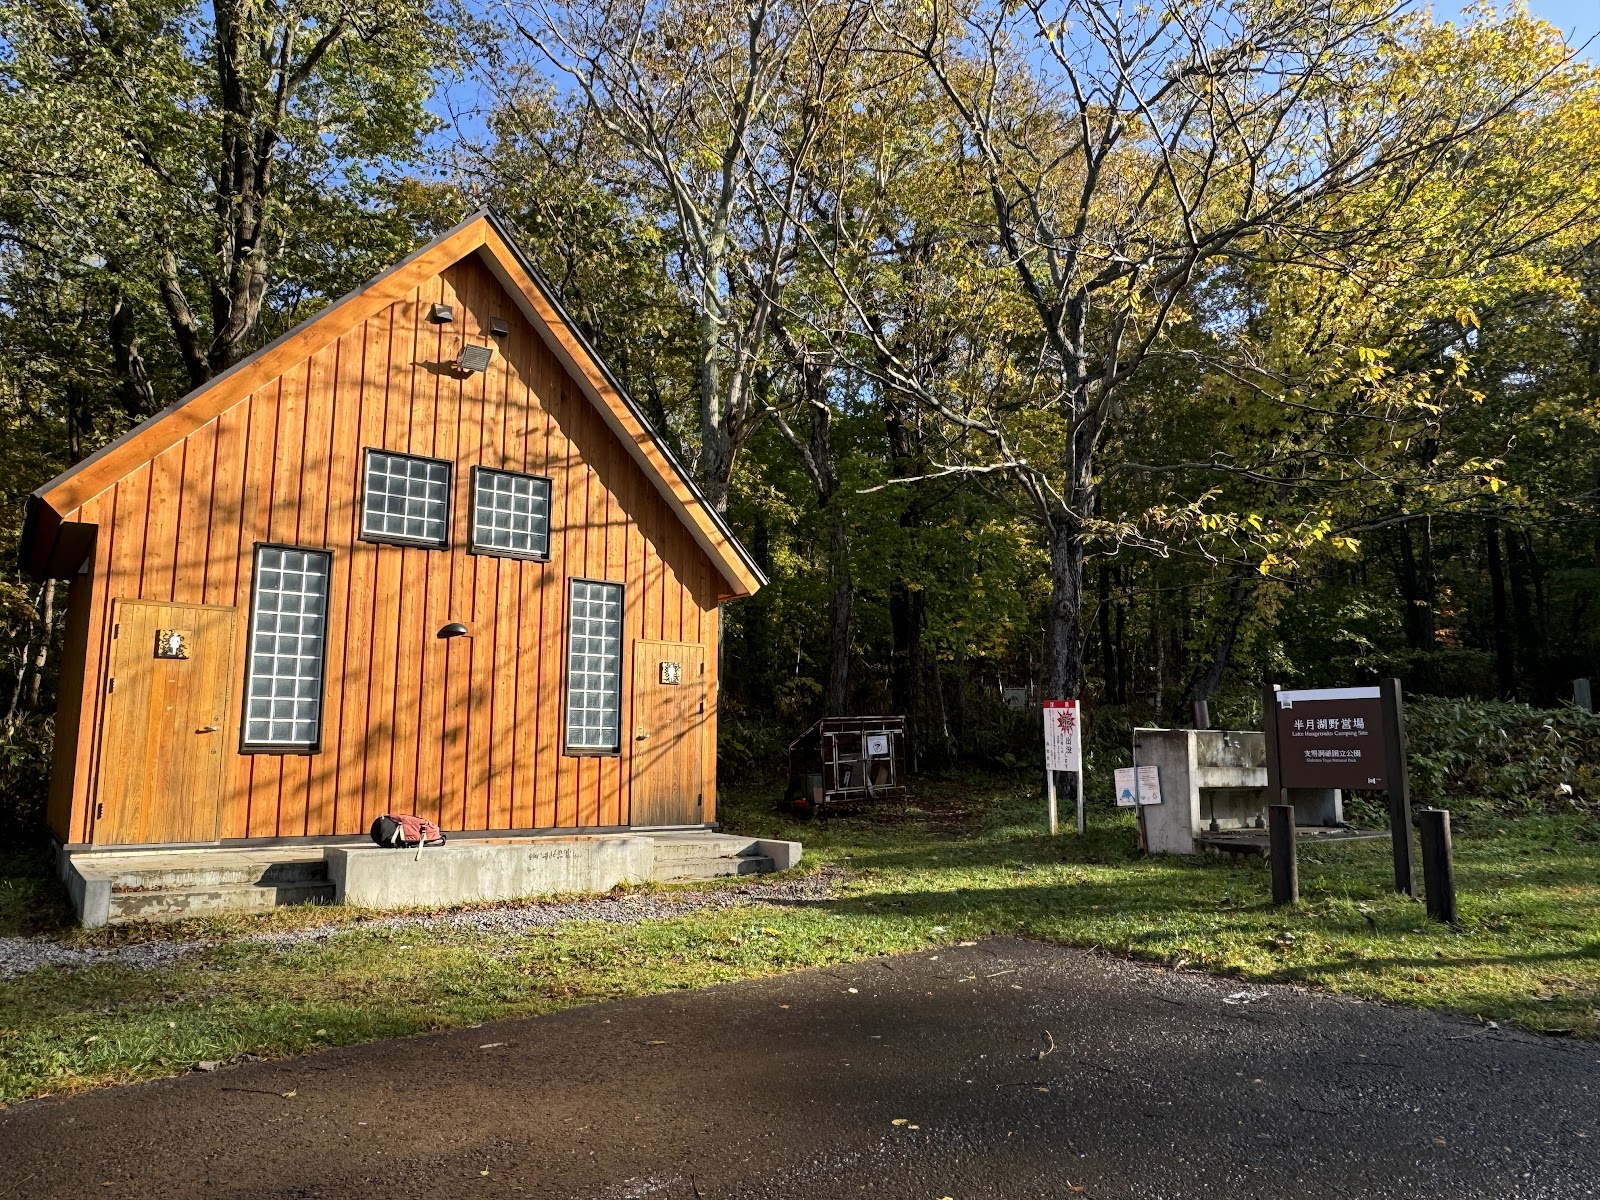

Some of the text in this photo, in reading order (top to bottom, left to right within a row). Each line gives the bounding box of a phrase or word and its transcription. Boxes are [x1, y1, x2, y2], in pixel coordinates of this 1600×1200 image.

[1293, 717, 1365, 730] 半月湖野営場
